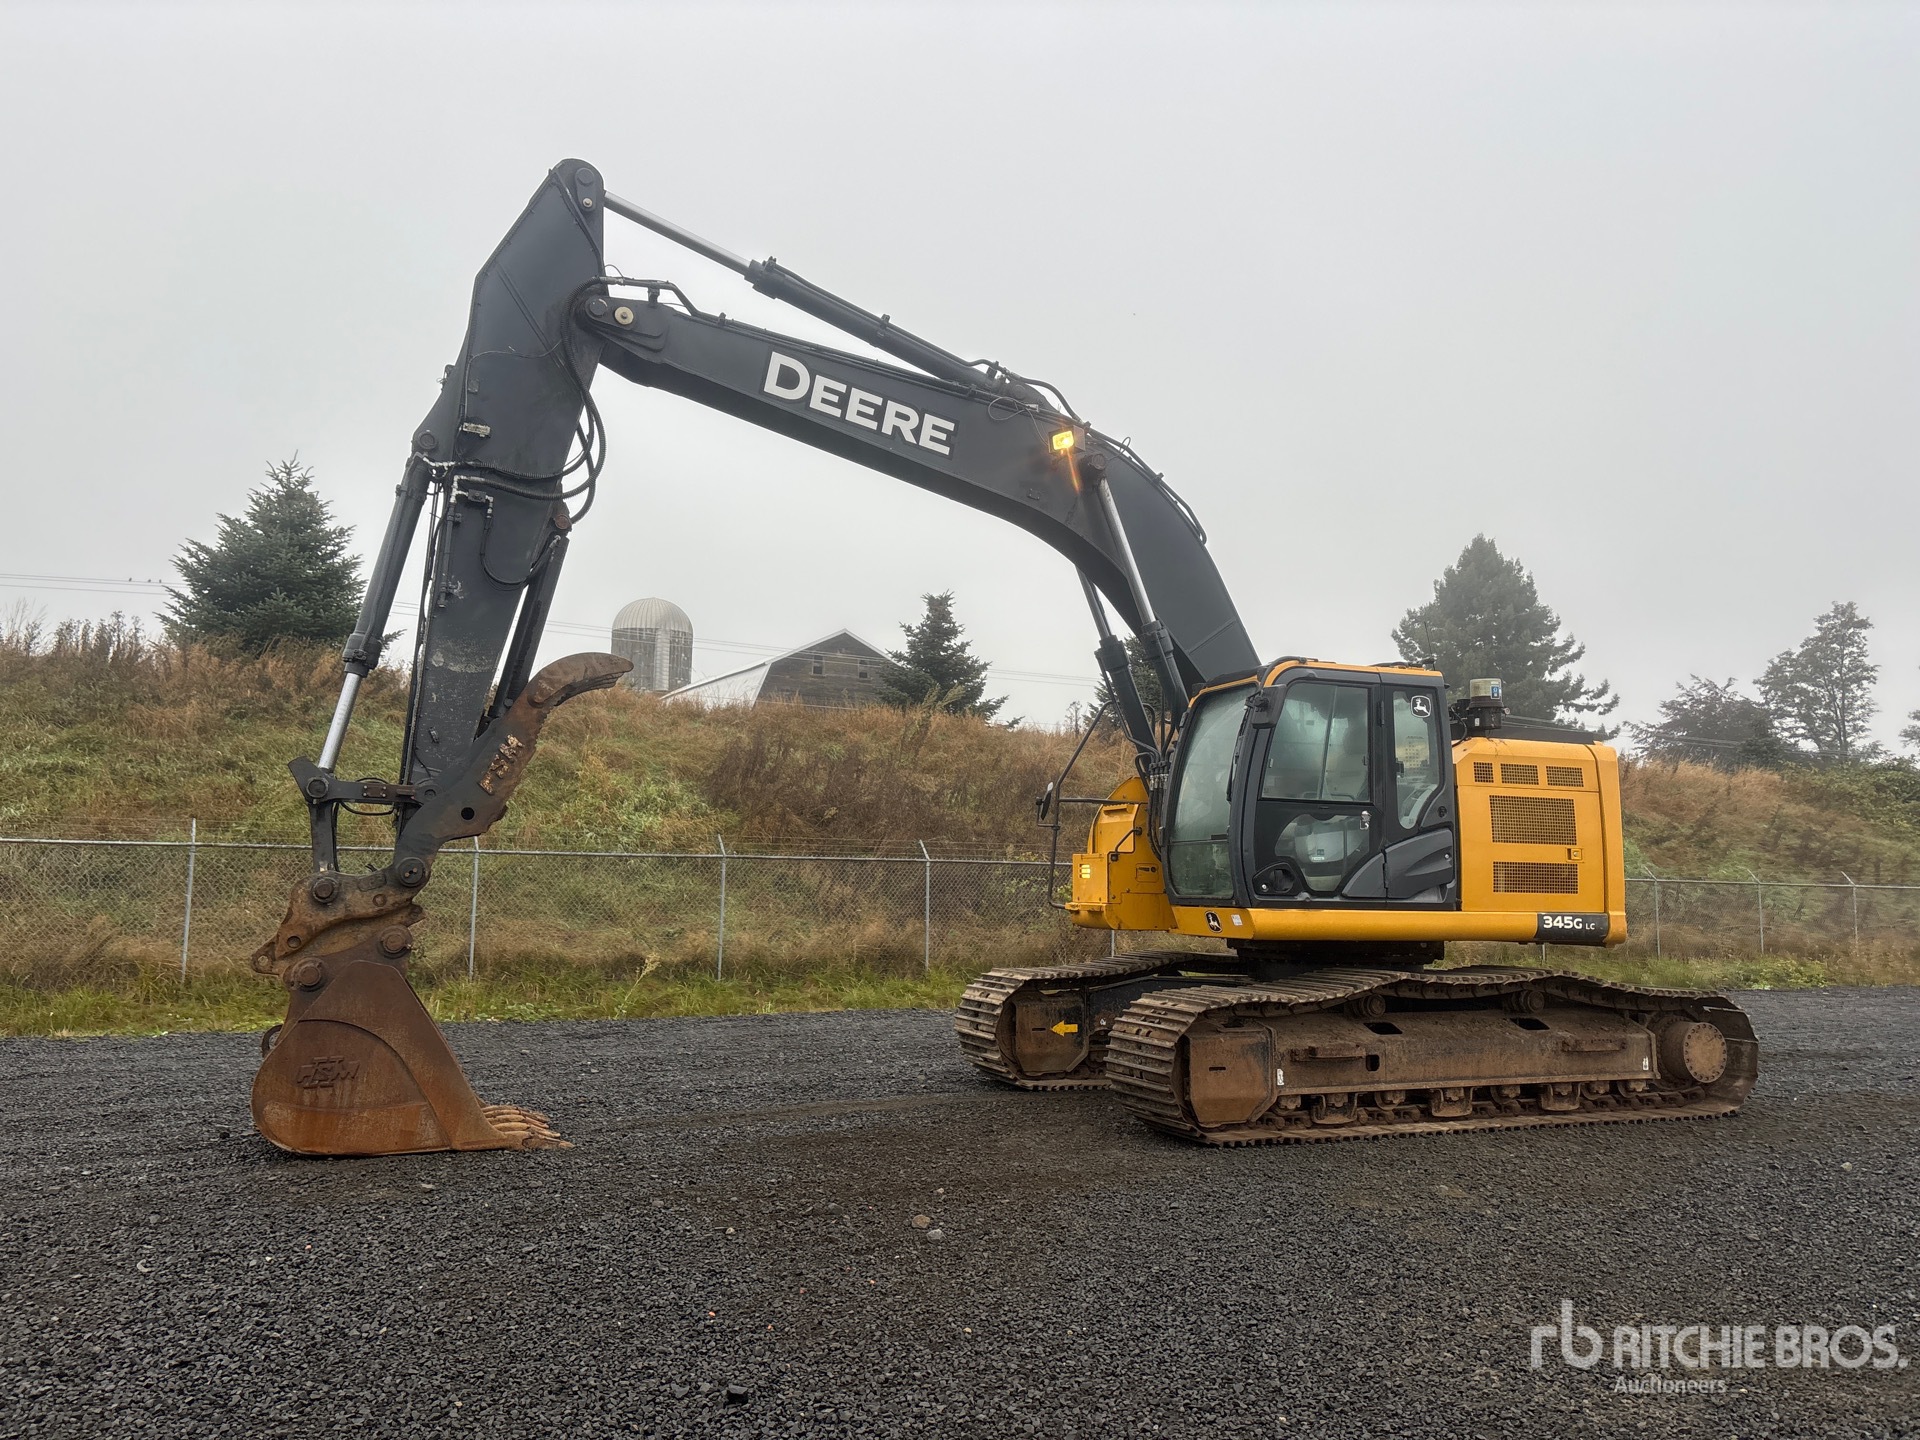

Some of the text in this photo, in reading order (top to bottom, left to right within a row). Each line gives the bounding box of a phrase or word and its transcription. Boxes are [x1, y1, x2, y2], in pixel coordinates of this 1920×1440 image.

[763, 351, 955, 455] DEERE
[1543, 915, 1595, 930] 345G LC
